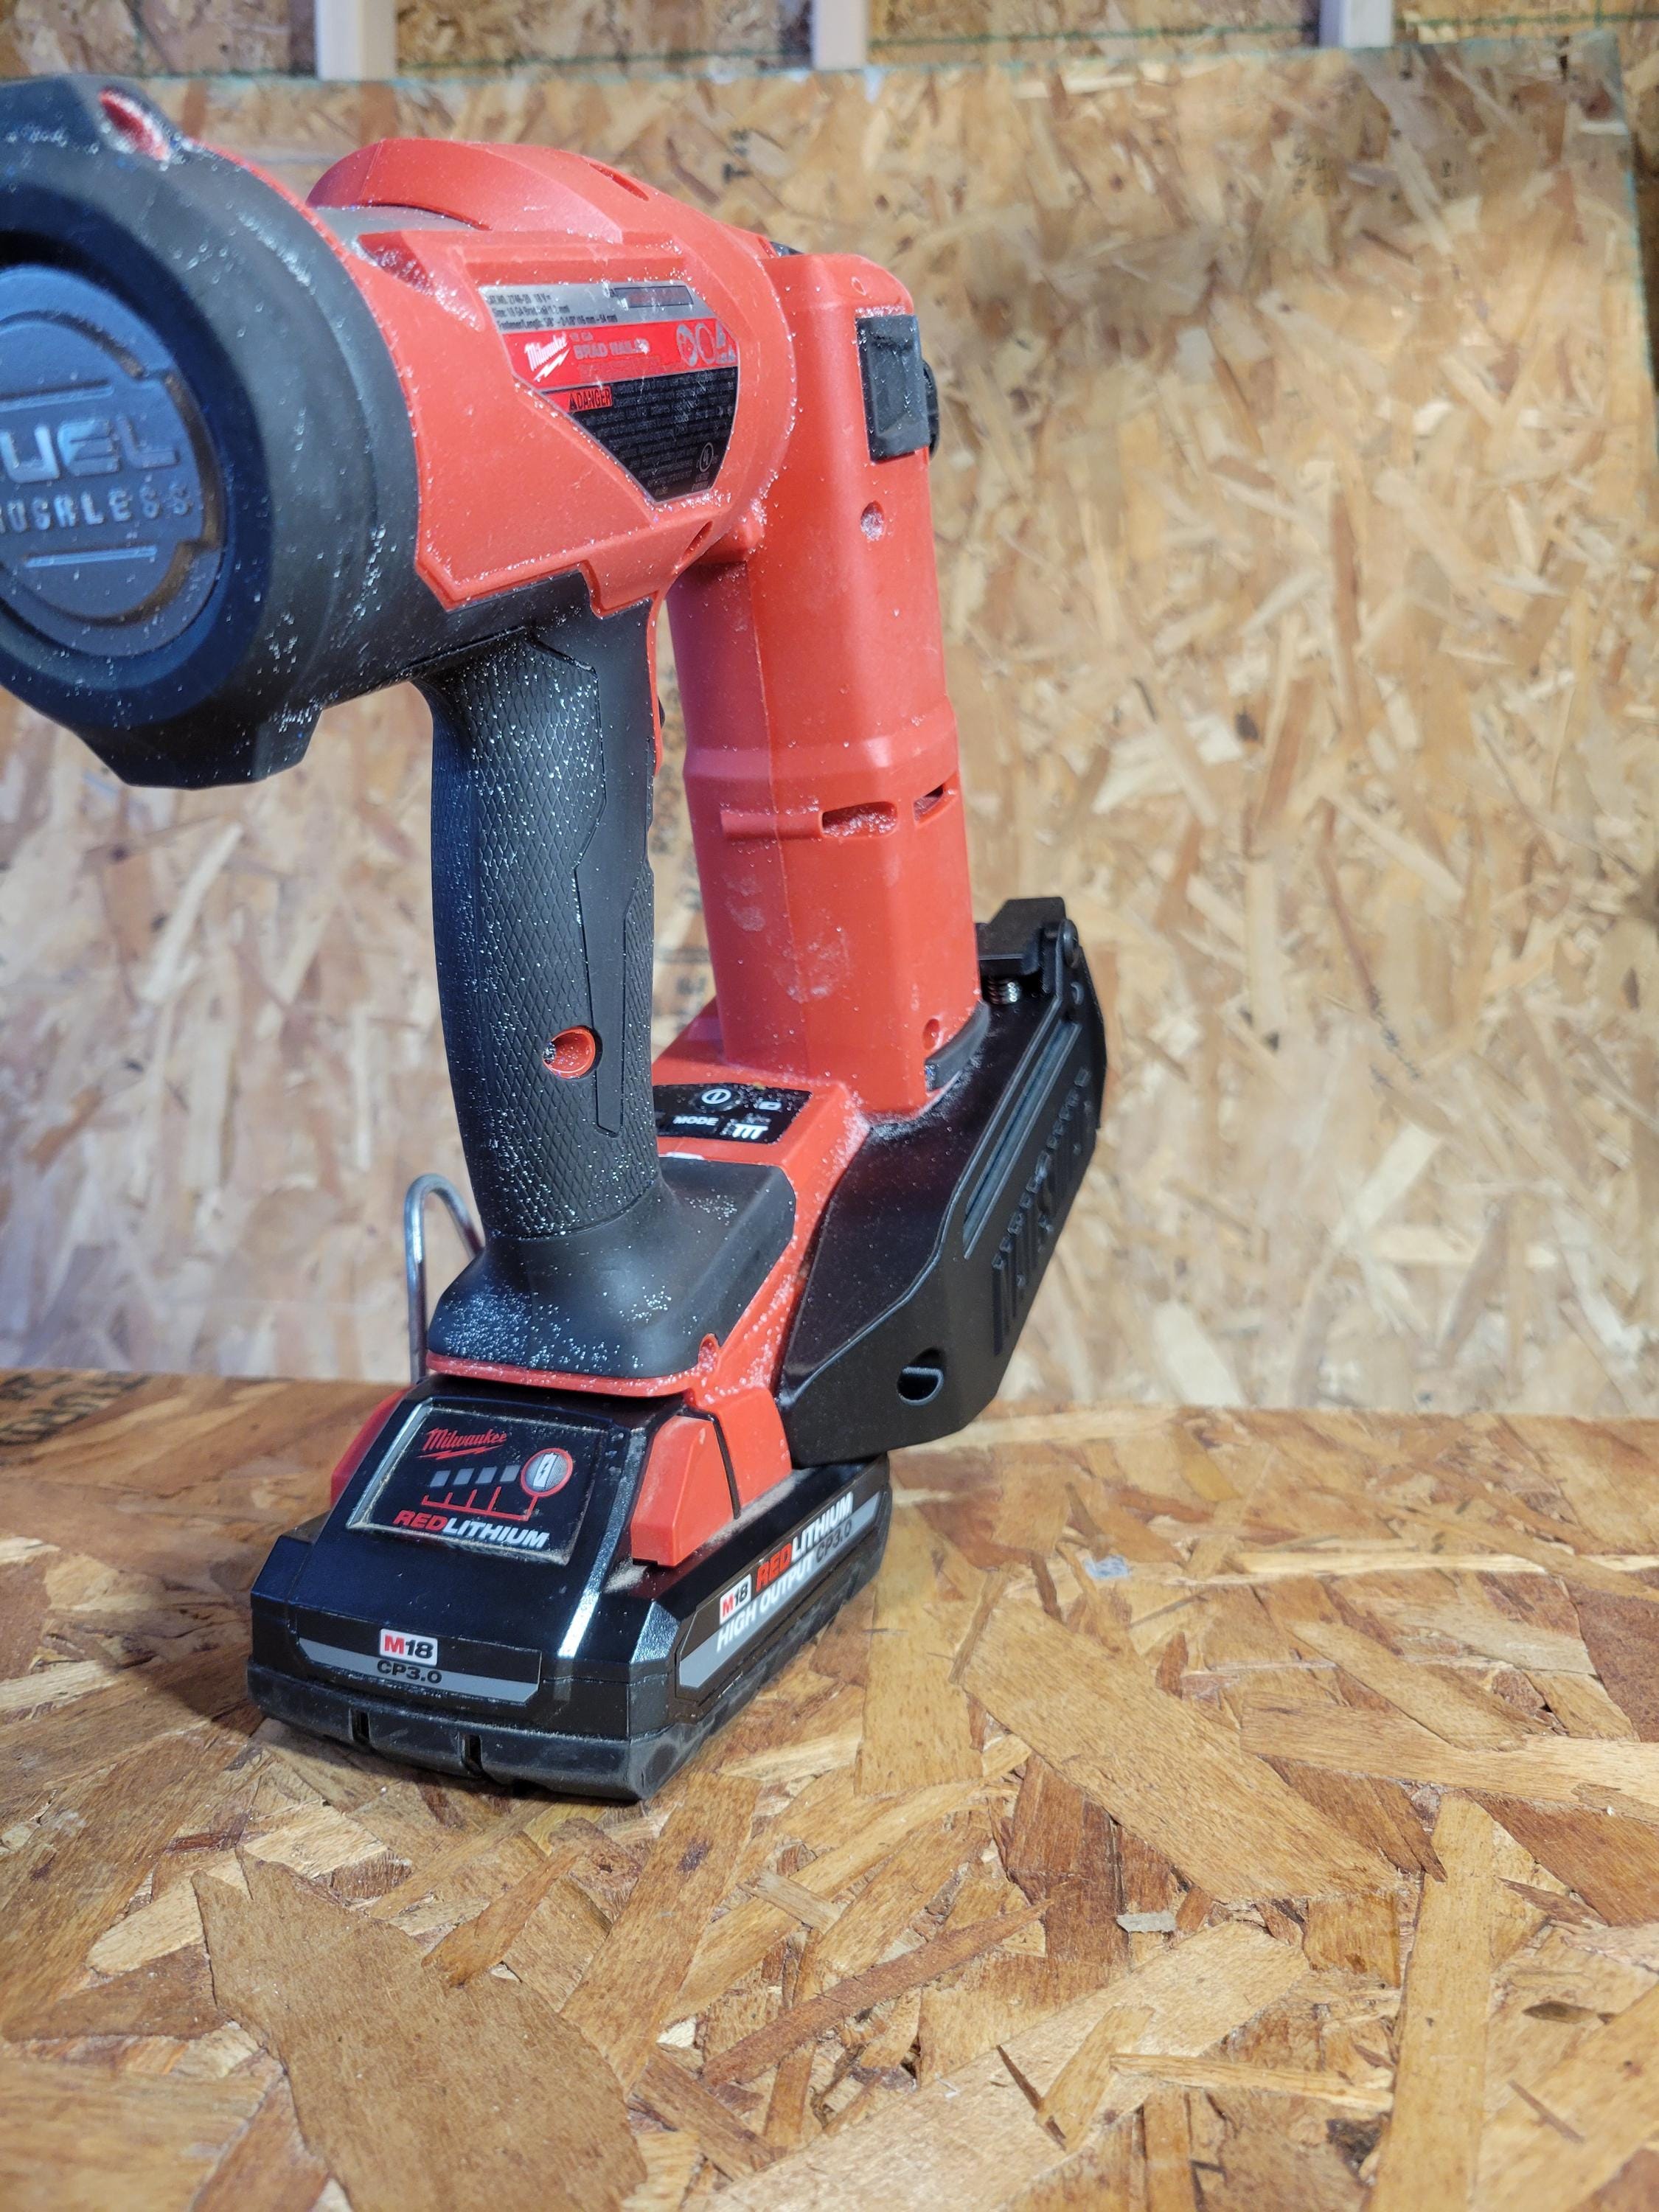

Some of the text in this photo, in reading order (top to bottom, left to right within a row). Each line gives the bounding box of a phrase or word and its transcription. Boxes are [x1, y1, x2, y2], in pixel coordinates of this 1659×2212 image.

[576, 386, 612, 410] DANGER
[672, 1116, 720, 1126] MODE
[422, 1427, 509, 1451] Milwaukee
[393, 1509, 550, 1549] REDLITHIUM
[722, 1491, 854, 1618] M18 REDLITHIUM
[716, 1520, 852, 1653] HIGH OUTPUT CP3.0
[383, 1635, 435, 1659] M18
[377, 1659, 442, 1684] CP3.0
